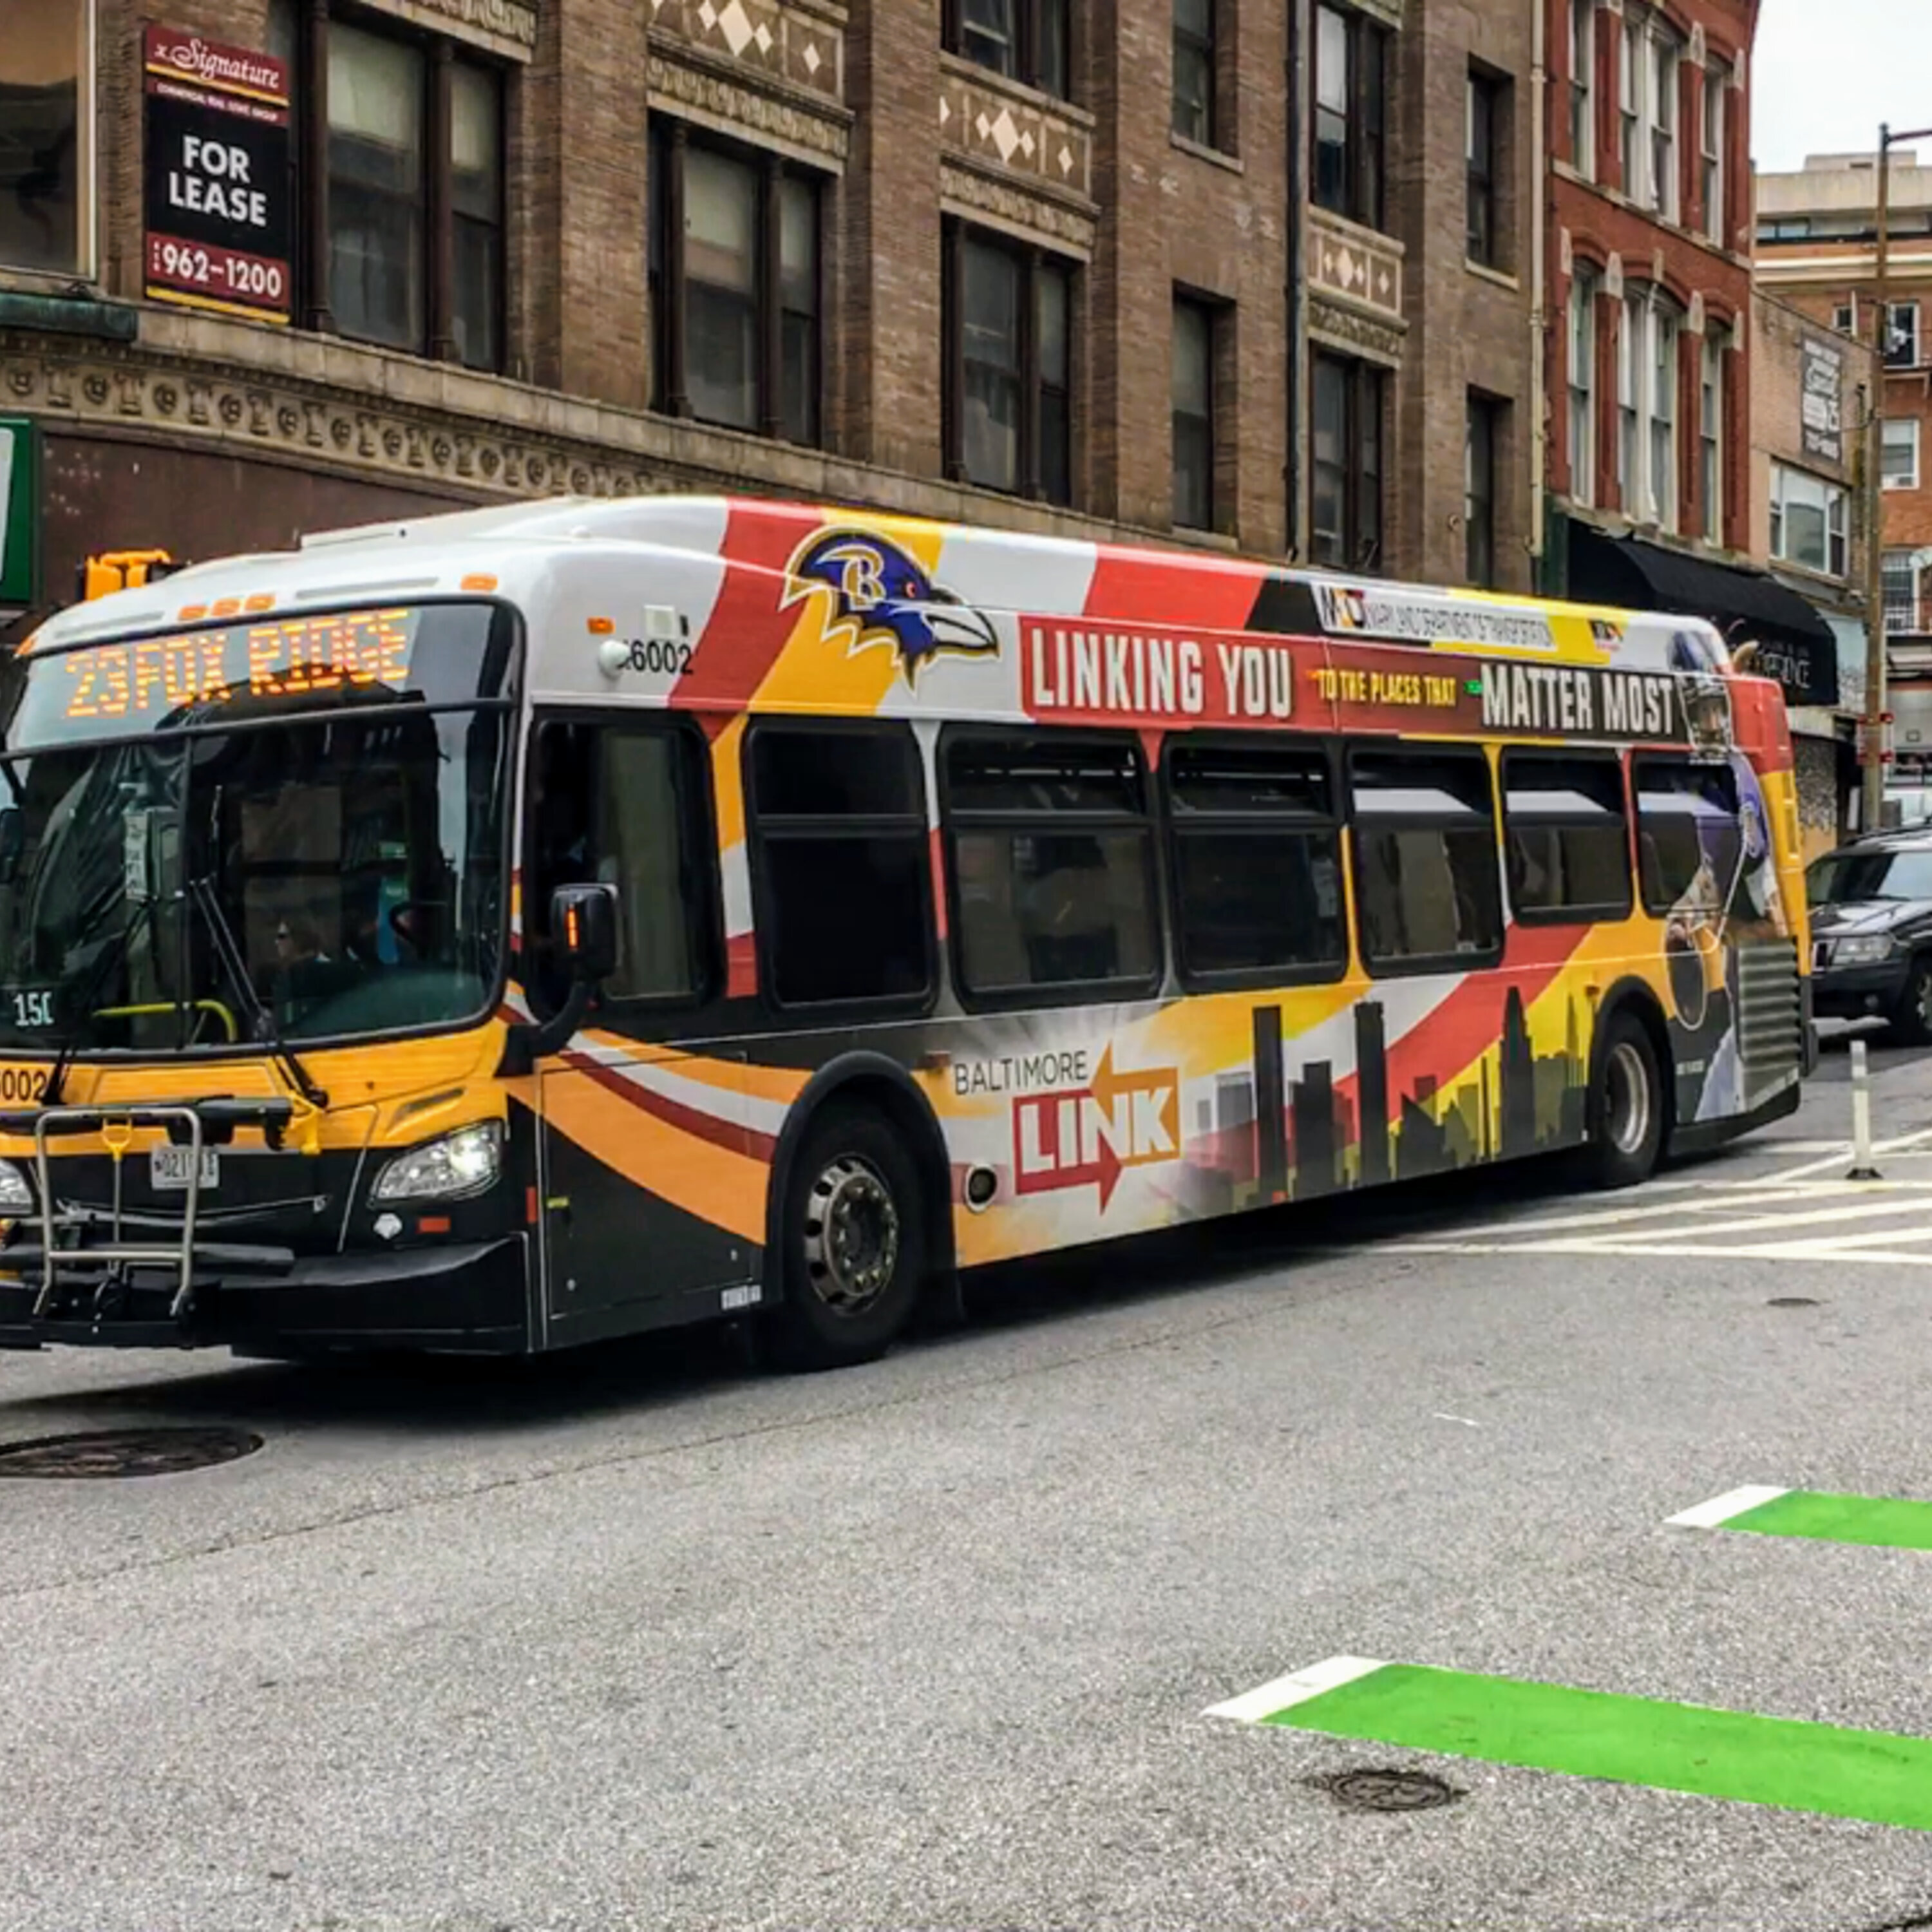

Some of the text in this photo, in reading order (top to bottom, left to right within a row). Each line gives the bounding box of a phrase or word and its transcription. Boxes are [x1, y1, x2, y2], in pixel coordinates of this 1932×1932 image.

[155, 38, 279, 89] Signature
[183, 134, 251, 184] FOR
[169, 171, 267, 226] LEASE
[162, 243, 281, 298] 962-1200
[135, 634, 231, 710] FOX
[249, 609, 409, 696] RIDGE
[623, 639, 694, 675] 6002
[1032, 628, 1291, 717] LINKING YOU
[1317, 669, 1457, 706] TO THE PLACES THAT
[1481, 664, 1672, 735] MATTER MOST
[0, 1070, 47, 1101] 002
[954, 1050, 1088, 1095] BALTIMORE
[1019, 1086, 1176, 1174] LINK
